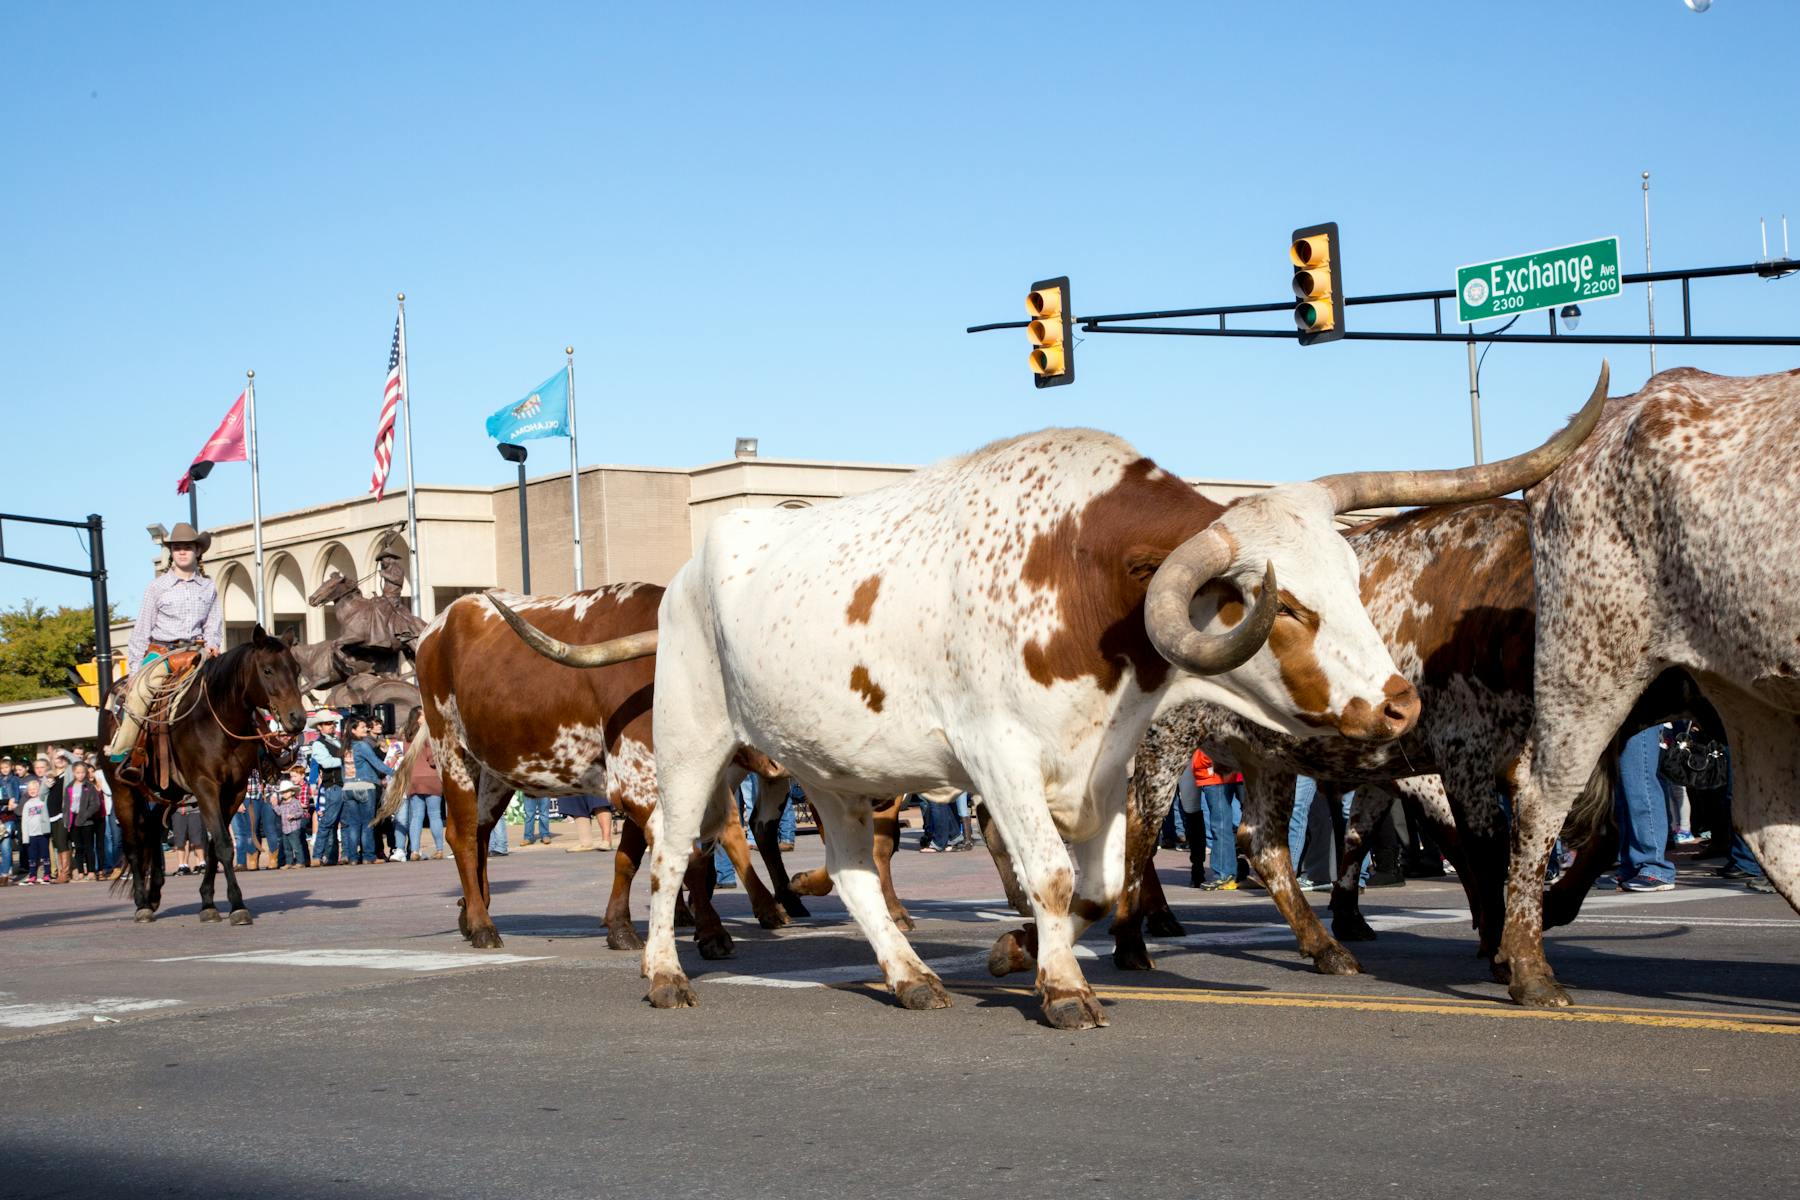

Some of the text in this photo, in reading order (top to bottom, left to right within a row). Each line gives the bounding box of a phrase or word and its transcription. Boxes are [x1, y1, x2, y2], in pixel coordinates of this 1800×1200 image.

[1490, 254, 1615, 297] Exchange Ave
[1583, 278, 1616, 296] 2200
[1492, 295, 1525, 312] 2300
